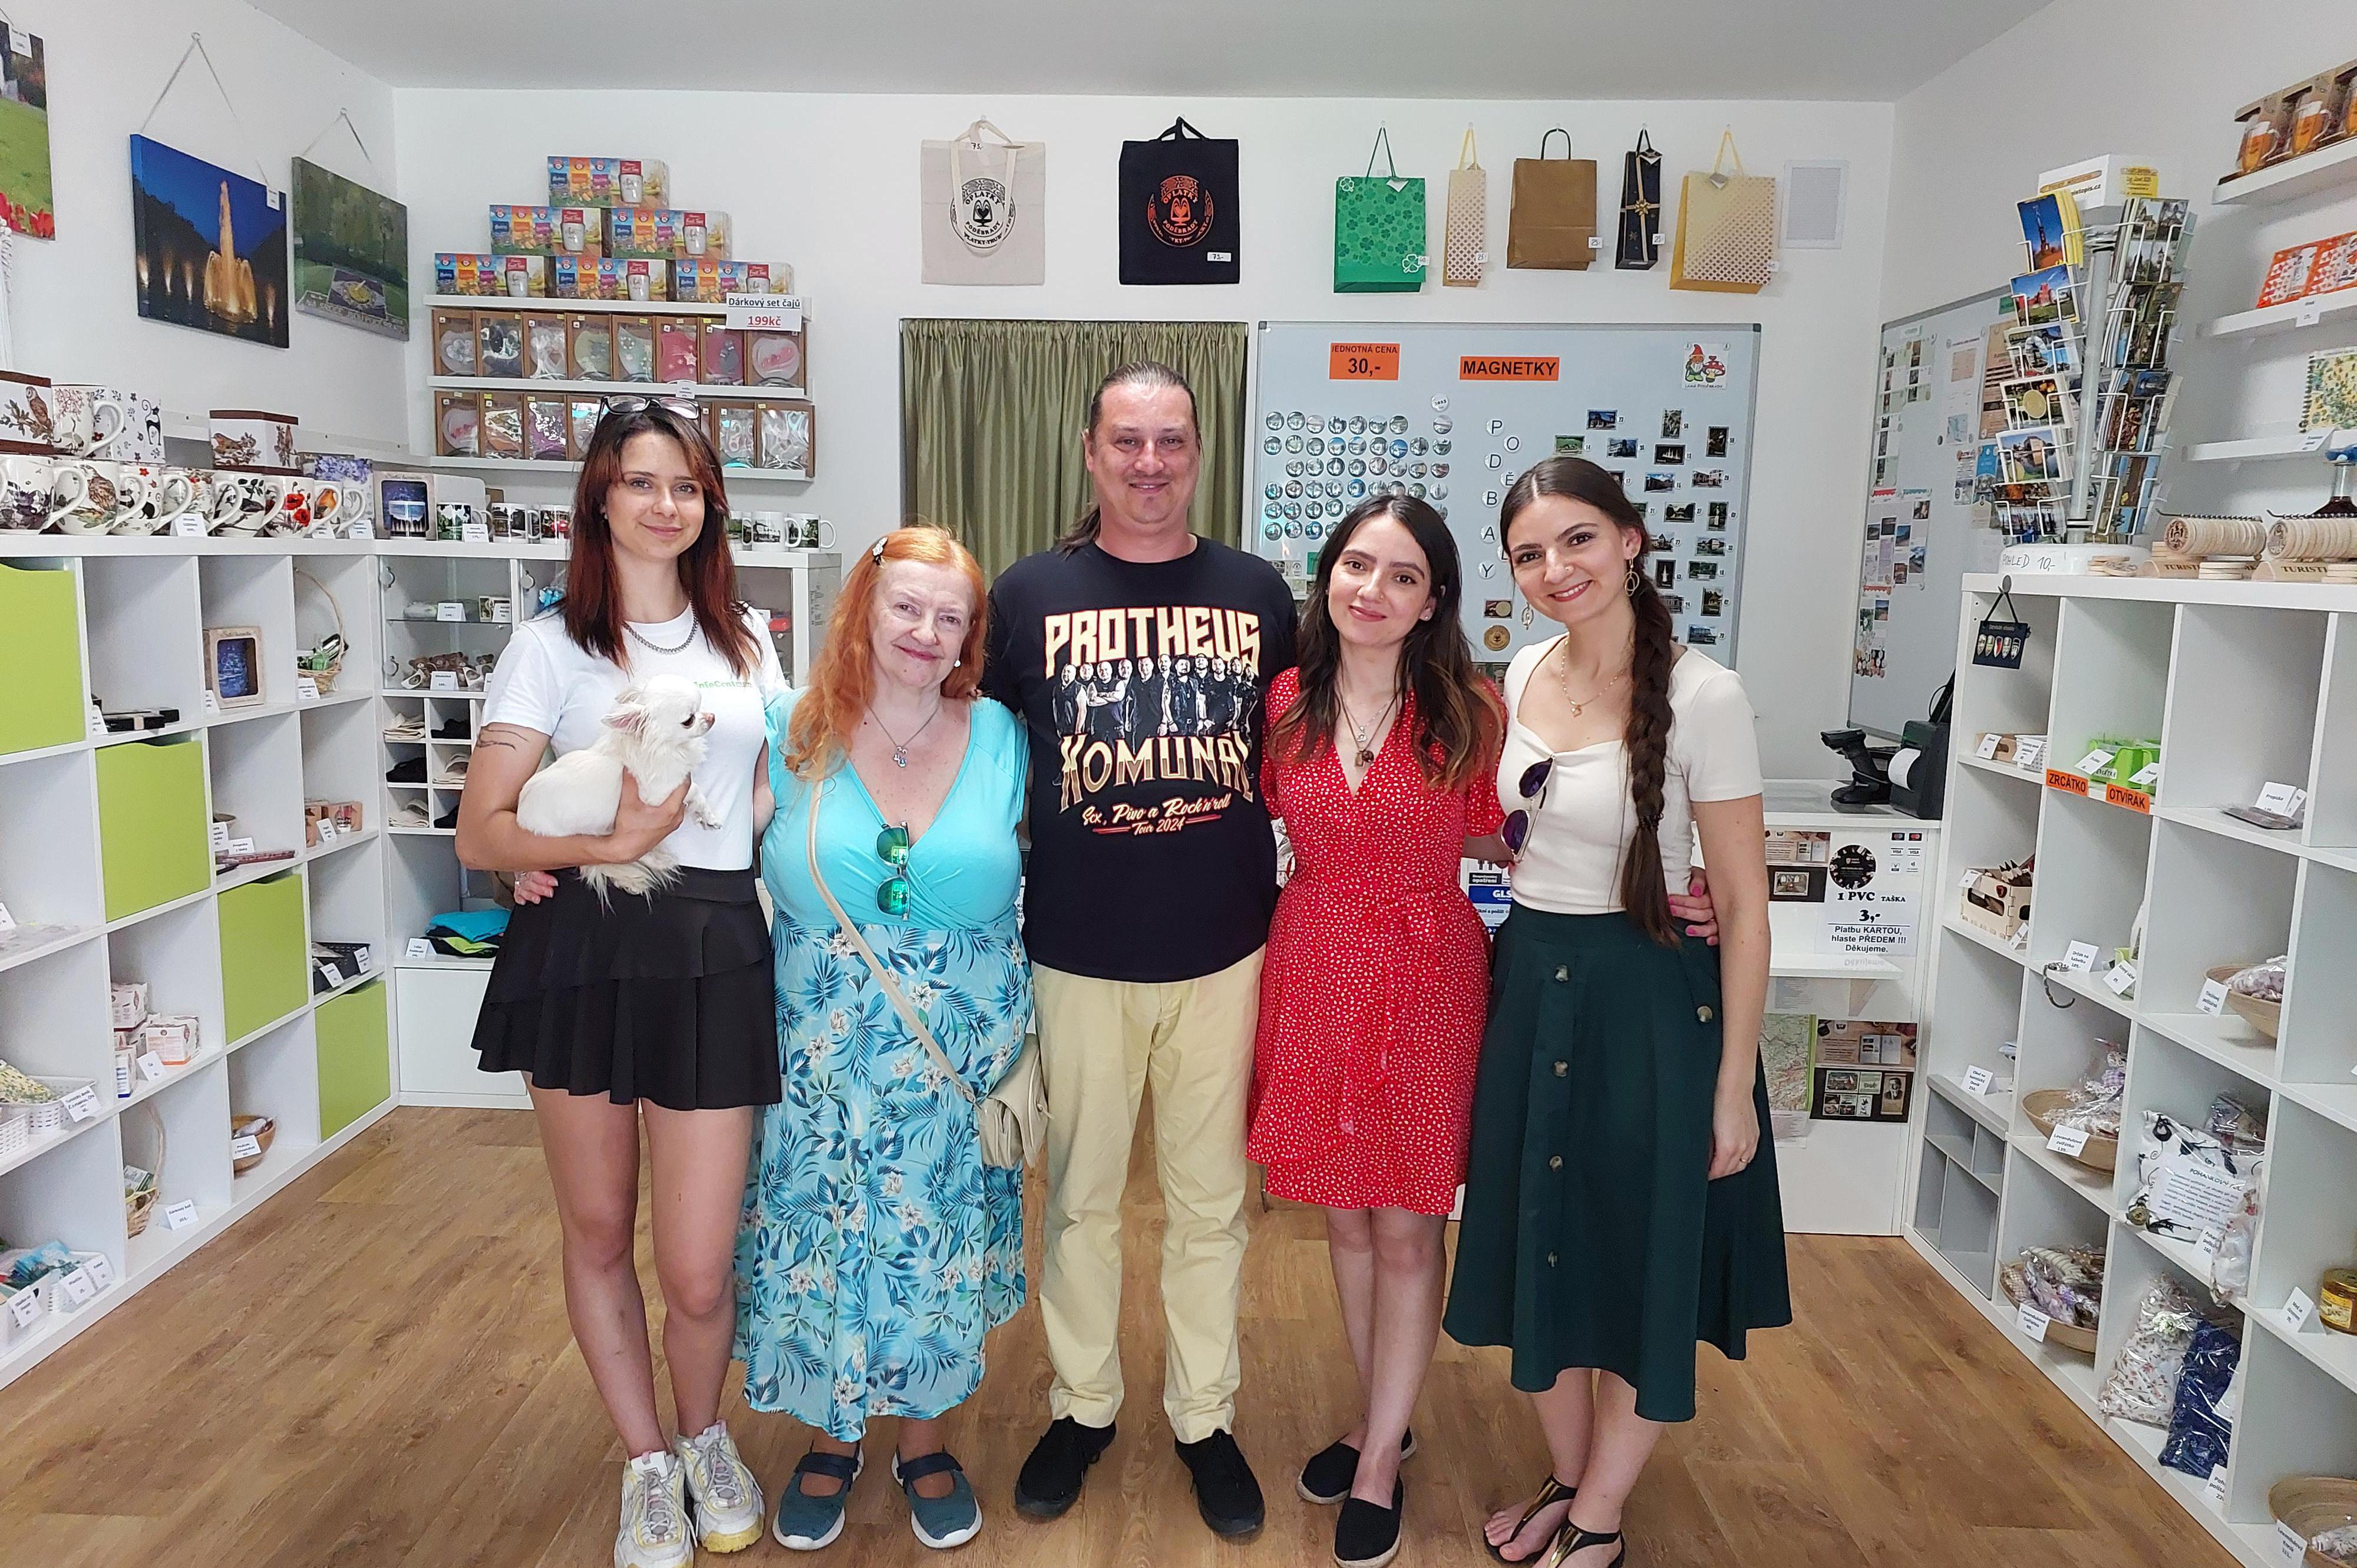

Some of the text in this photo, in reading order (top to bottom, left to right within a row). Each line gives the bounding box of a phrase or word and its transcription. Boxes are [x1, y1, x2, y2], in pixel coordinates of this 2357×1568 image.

[965, 192, 1001, 205] OPLATKY
[1163, 189, 1199, 204] OPLATKY
[965, 220, 1001, 235] PODĚBRADY
[1163, 219, 1198, 233] PODĚBRADY
[728, 298, 764, 308] Dárkový
[783, 298, 801, 308] čajů
[748, 316, 781, 326] 199kč
[1332, 344, 1398, 354] JEDNOTNÁ CENA
[1348, 358, 1381, 377] 30,-
[1463, 360, 1557, 376] MAGNETKY
[2037, 556, 2056, 572] 10,-
[1044, 606, 1260, 679] PROTHEUS
[1059, 730, 1254, 814] KOMUNÁL
[2049, 773, 2086, 793] ZRCÁTKO
[2109, 788, 2145, 809] OTVÍRÁK
[1112, 803, 1146, 824] Pivo
[1148, 807, 1160, 818] a
[1131, 817, 1186, 836] Tour 2024
[1492, 889, 1512, 898] GLS
[1837, 892, 1844, 901] 1
[1848, 892, 1876, 901] PVC
[1859, 909, 1881, 923] 3,-
[1863, 927, 1902, 935] KARTOU,
[1859, 934, 1896, 943] PŘEDEM
[1846, 944, 1889, 953] Děkujeme.
